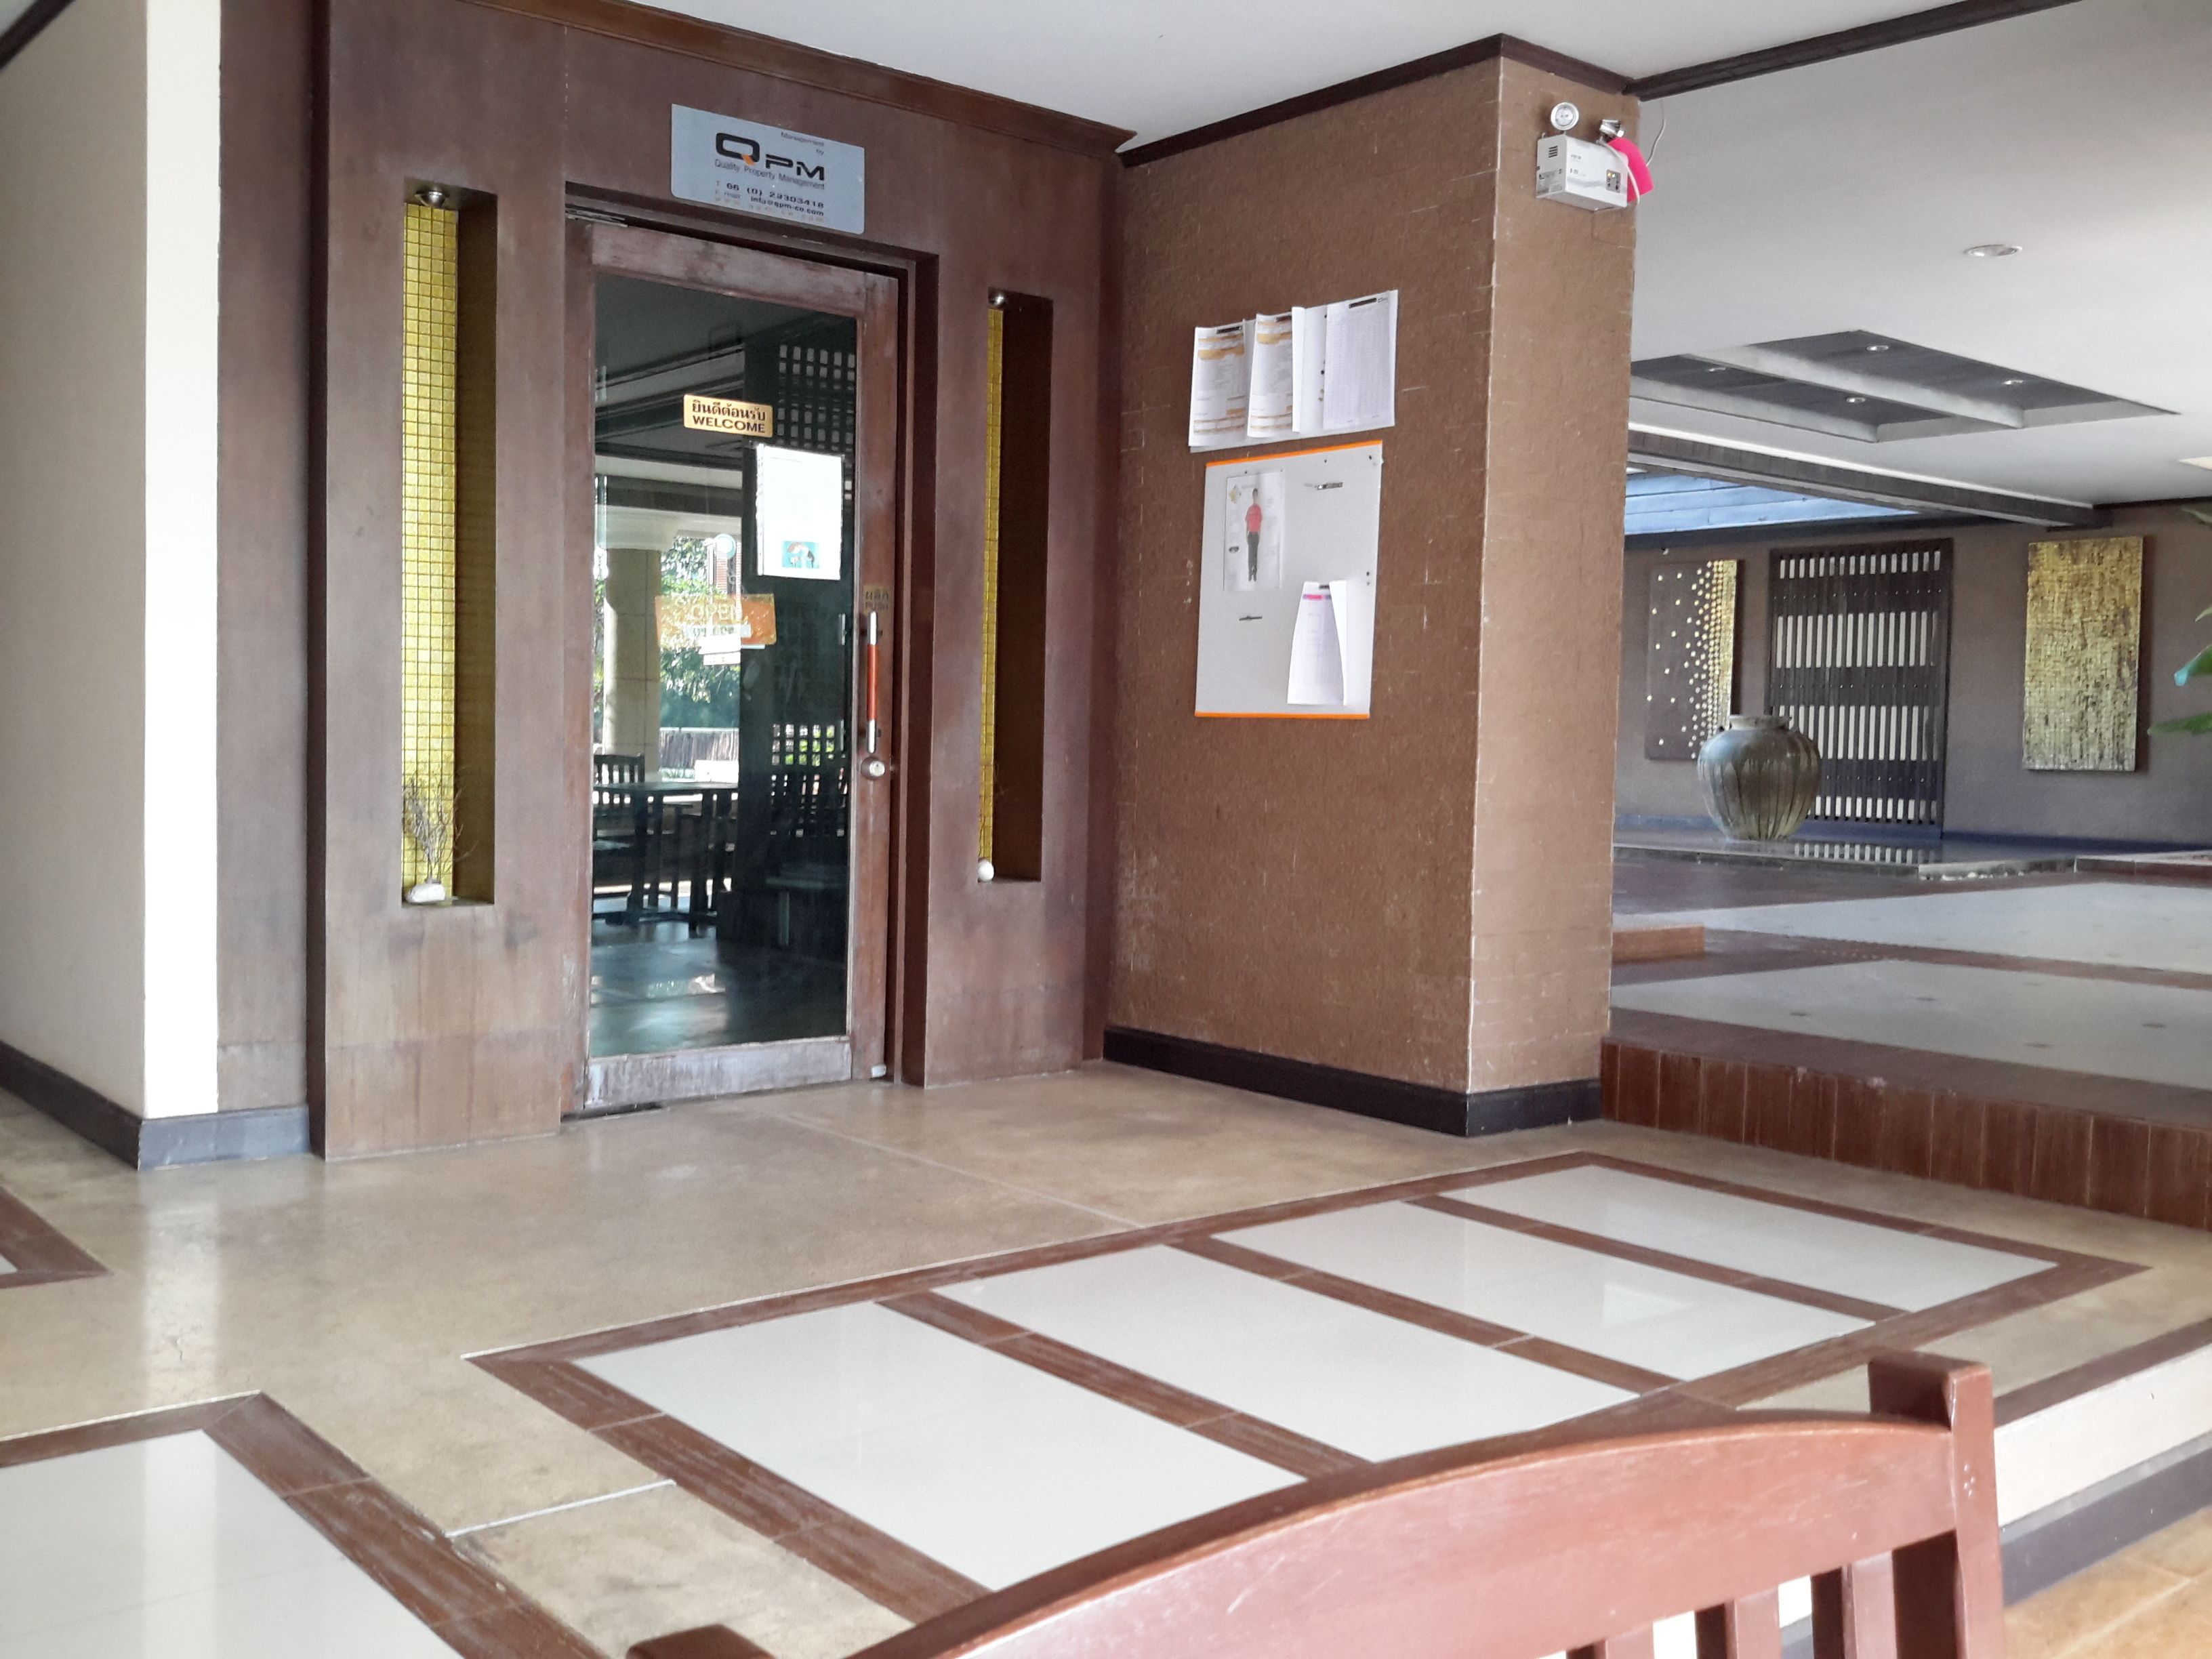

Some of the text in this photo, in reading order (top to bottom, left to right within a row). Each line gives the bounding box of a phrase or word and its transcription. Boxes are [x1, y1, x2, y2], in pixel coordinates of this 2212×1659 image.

[716, 133, 825, 181] QPM
[715, 159, 825, 190] Quality Property Management
[692, 399, 765, 422] ยินดีต้อนรับ
[692, 415, 766, 434] WELCOME
